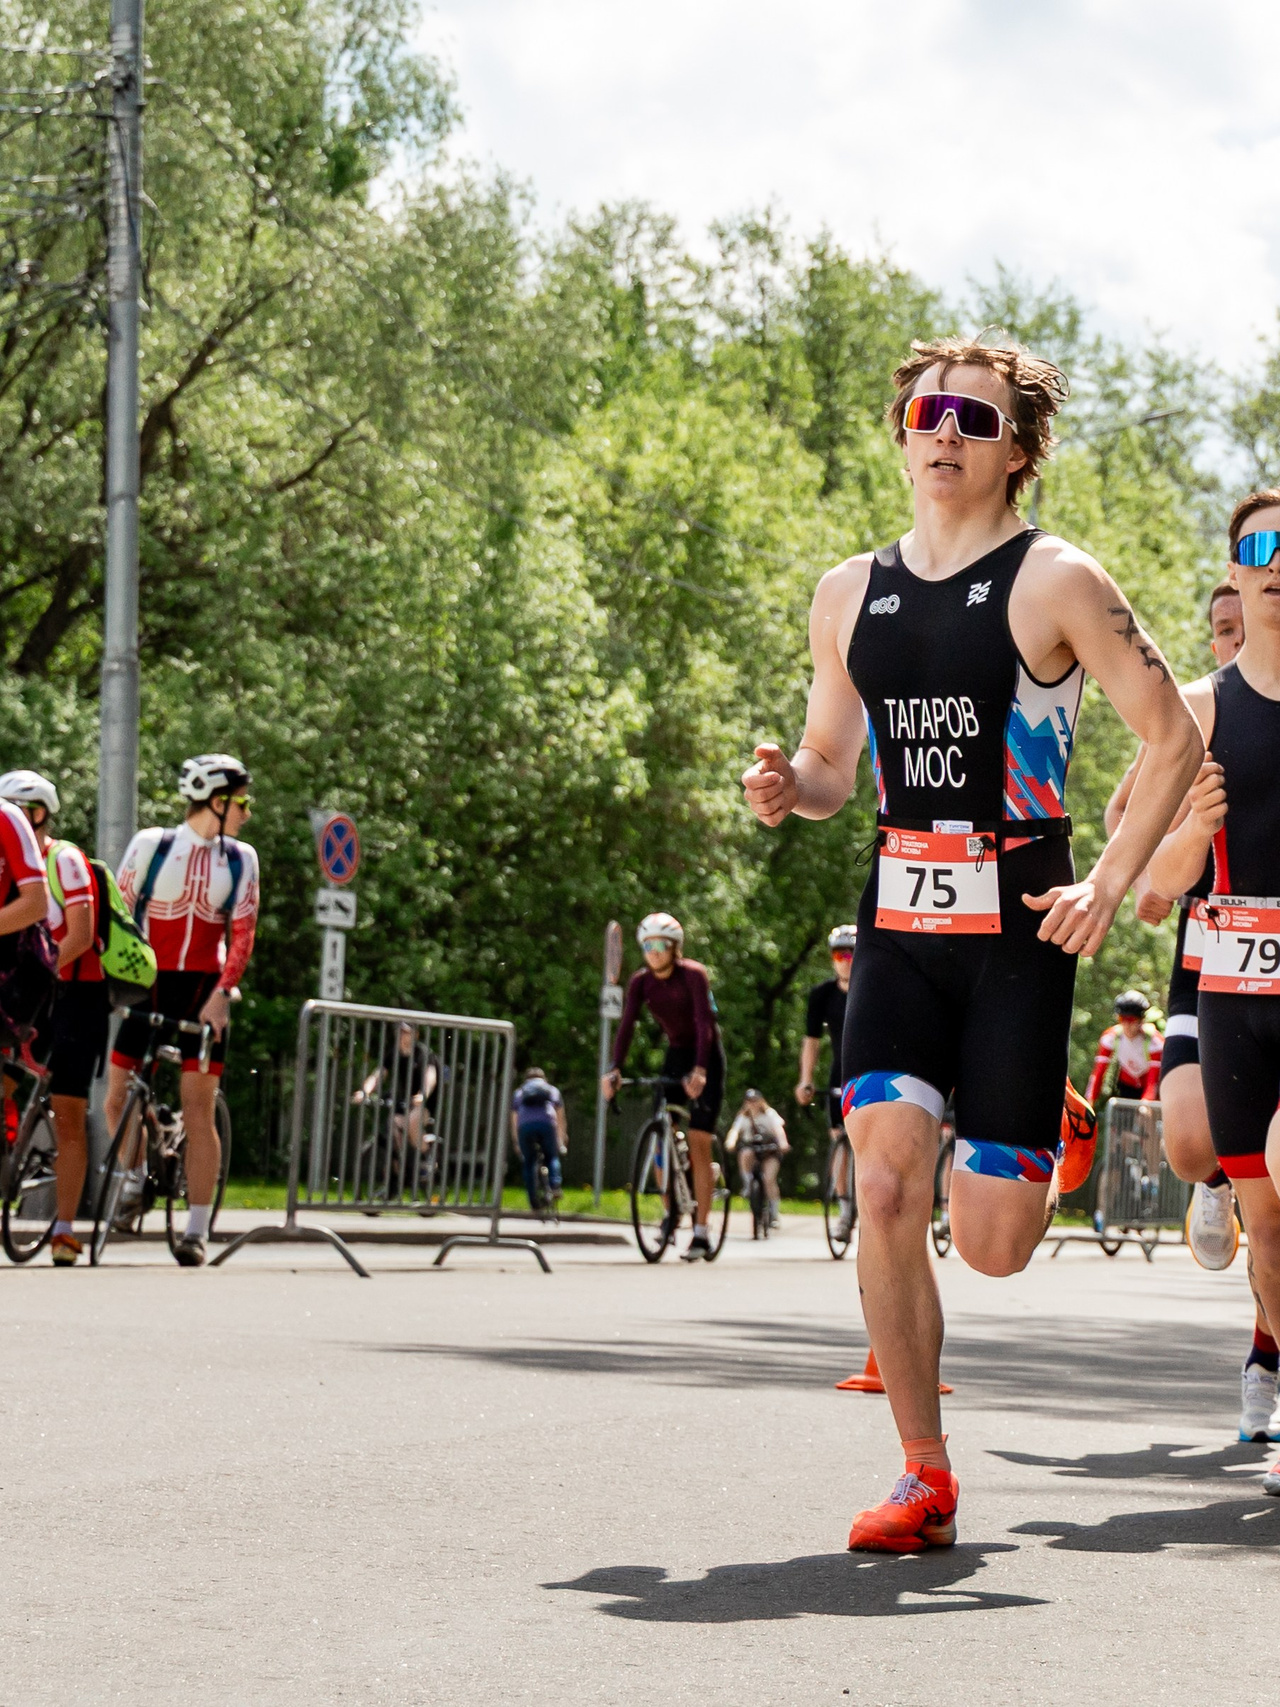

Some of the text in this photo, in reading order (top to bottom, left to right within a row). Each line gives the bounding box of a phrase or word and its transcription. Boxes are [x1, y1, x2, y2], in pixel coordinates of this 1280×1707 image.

[884, 696, 980, 739] ТАГАРОВ
[904, 745, 966, 788] МОС
[906, 866, 957, 908] 75
